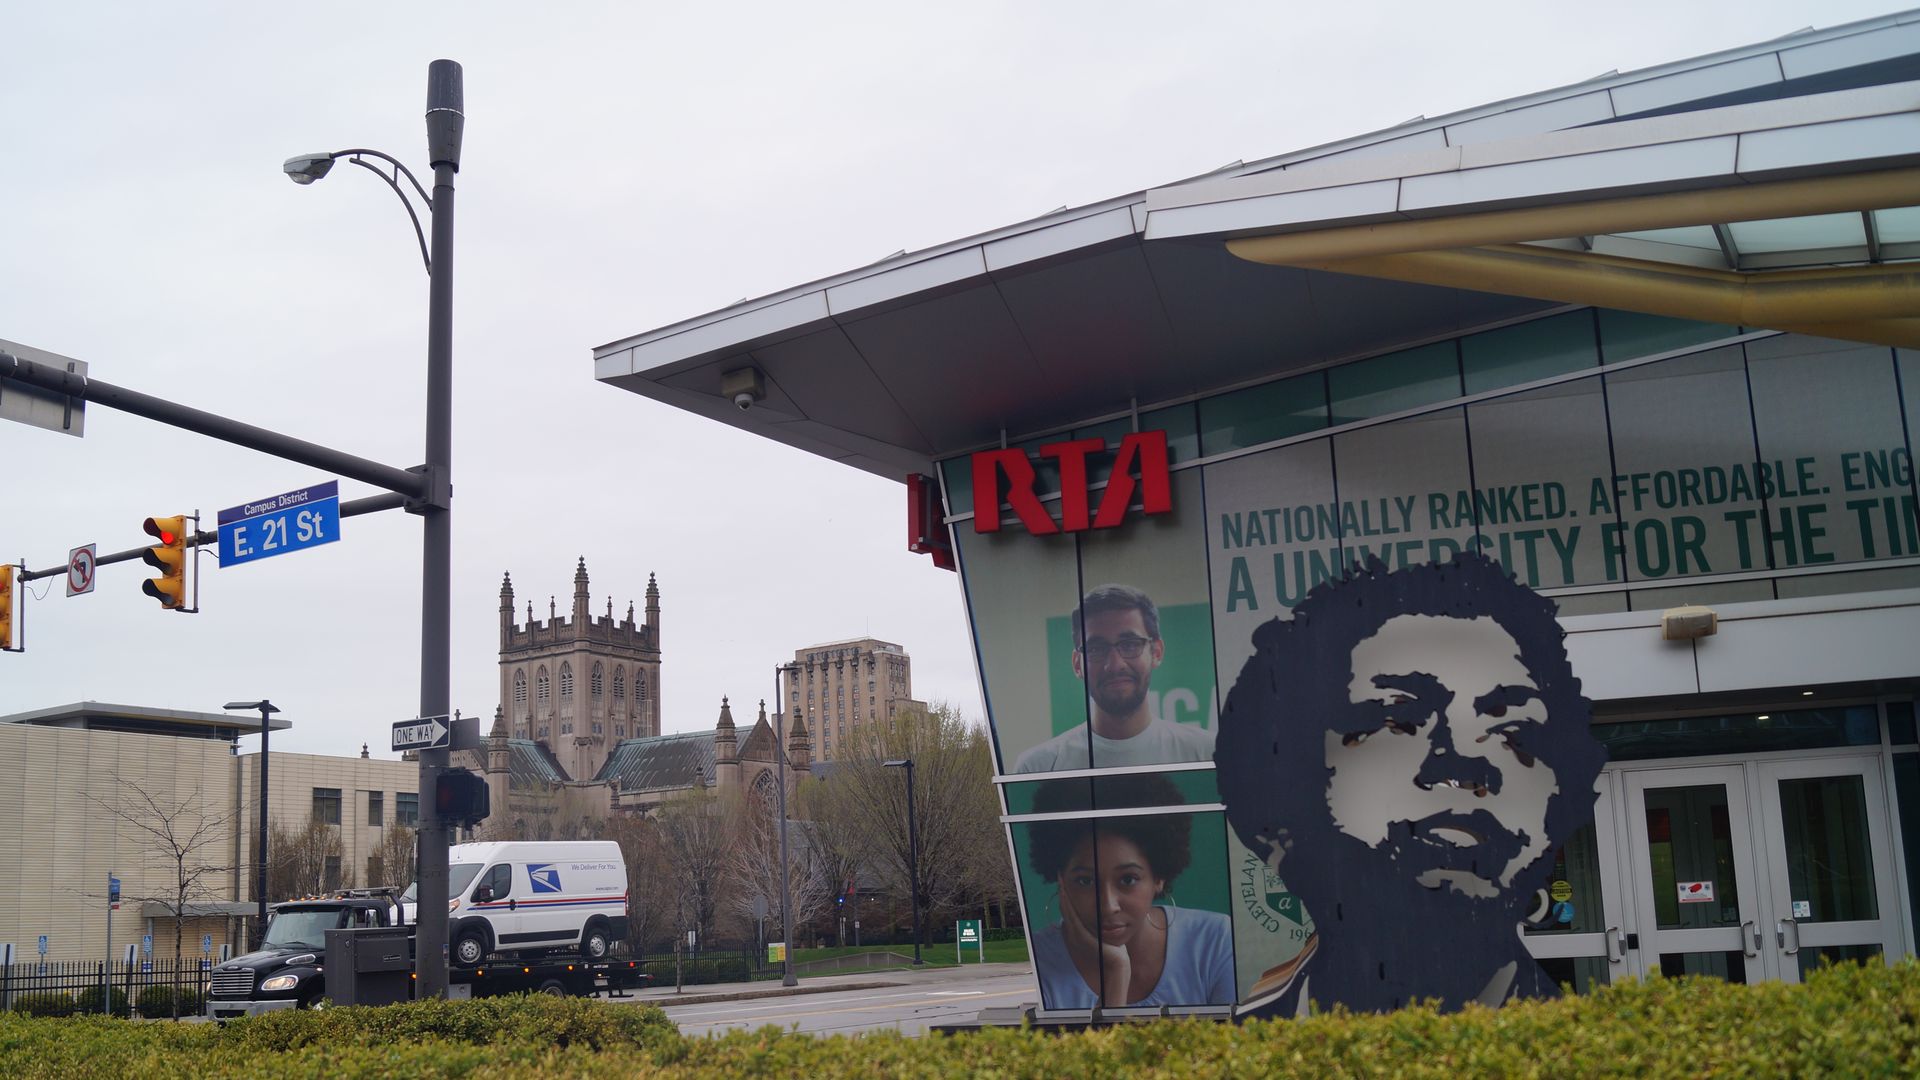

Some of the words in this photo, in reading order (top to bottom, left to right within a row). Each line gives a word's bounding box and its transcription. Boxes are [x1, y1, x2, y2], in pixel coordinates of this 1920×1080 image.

[244, 500, 276, 516] Campus
[278, 491, 308, 507] District
[971, 429, 1172, 537] RTA
[1222, 495, 1416, 549] NATIONALLY
[1428, 481, 1577, 531] RANKED.
[1589, 457, 1830, 516] AFFORDABLE.
[1841, 447, 1920, 492] ENG
[233, 526, 253, 558] E.
[262, 516, 287, 551] 21
[296, 510, 323, 542] St
[1226, 556, 1259, 613] A
[1601, 516, 1712, 581] FOR
[1724, 504, 1835, 570] THE
[396, 728, 413, 744] ONE
[417, 724, 435, 741] WAY
[571, 863, 580, 871] We
[580, 863, 598, 871] Deliver
